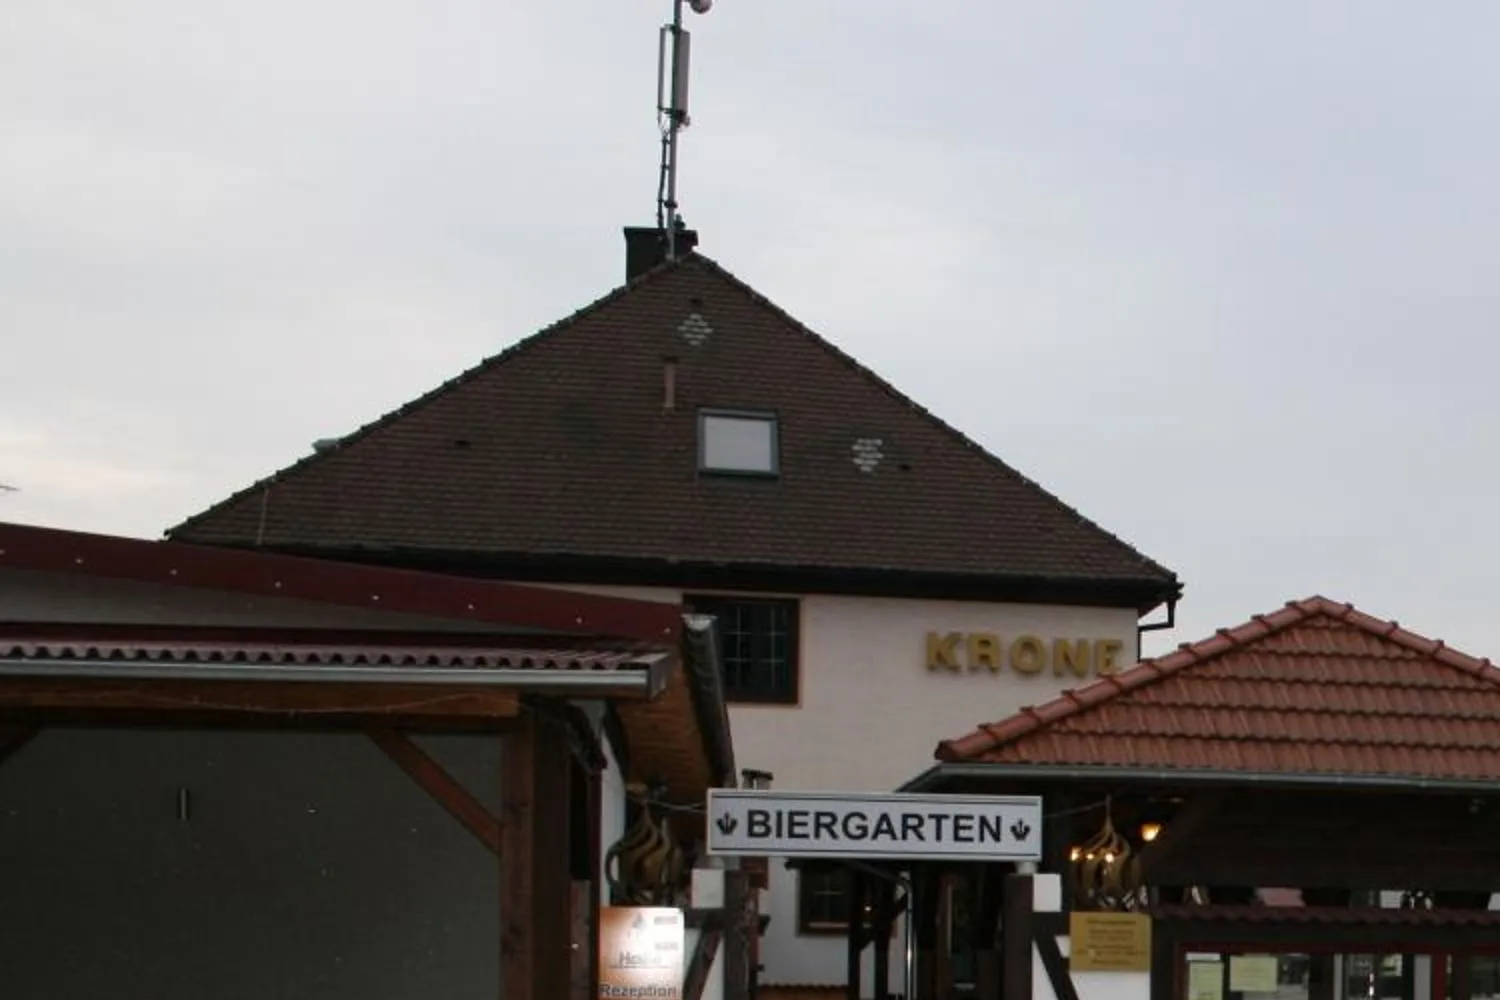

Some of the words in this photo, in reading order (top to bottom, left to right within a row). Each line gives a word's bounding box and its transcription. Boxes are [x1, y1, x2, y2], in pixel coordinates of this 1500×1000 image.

[926, 631, 1123, 677] KRONE
[747, 809, 1002, 843] BIERGARTEN
[600, 984, 677, 998] Rezeption
